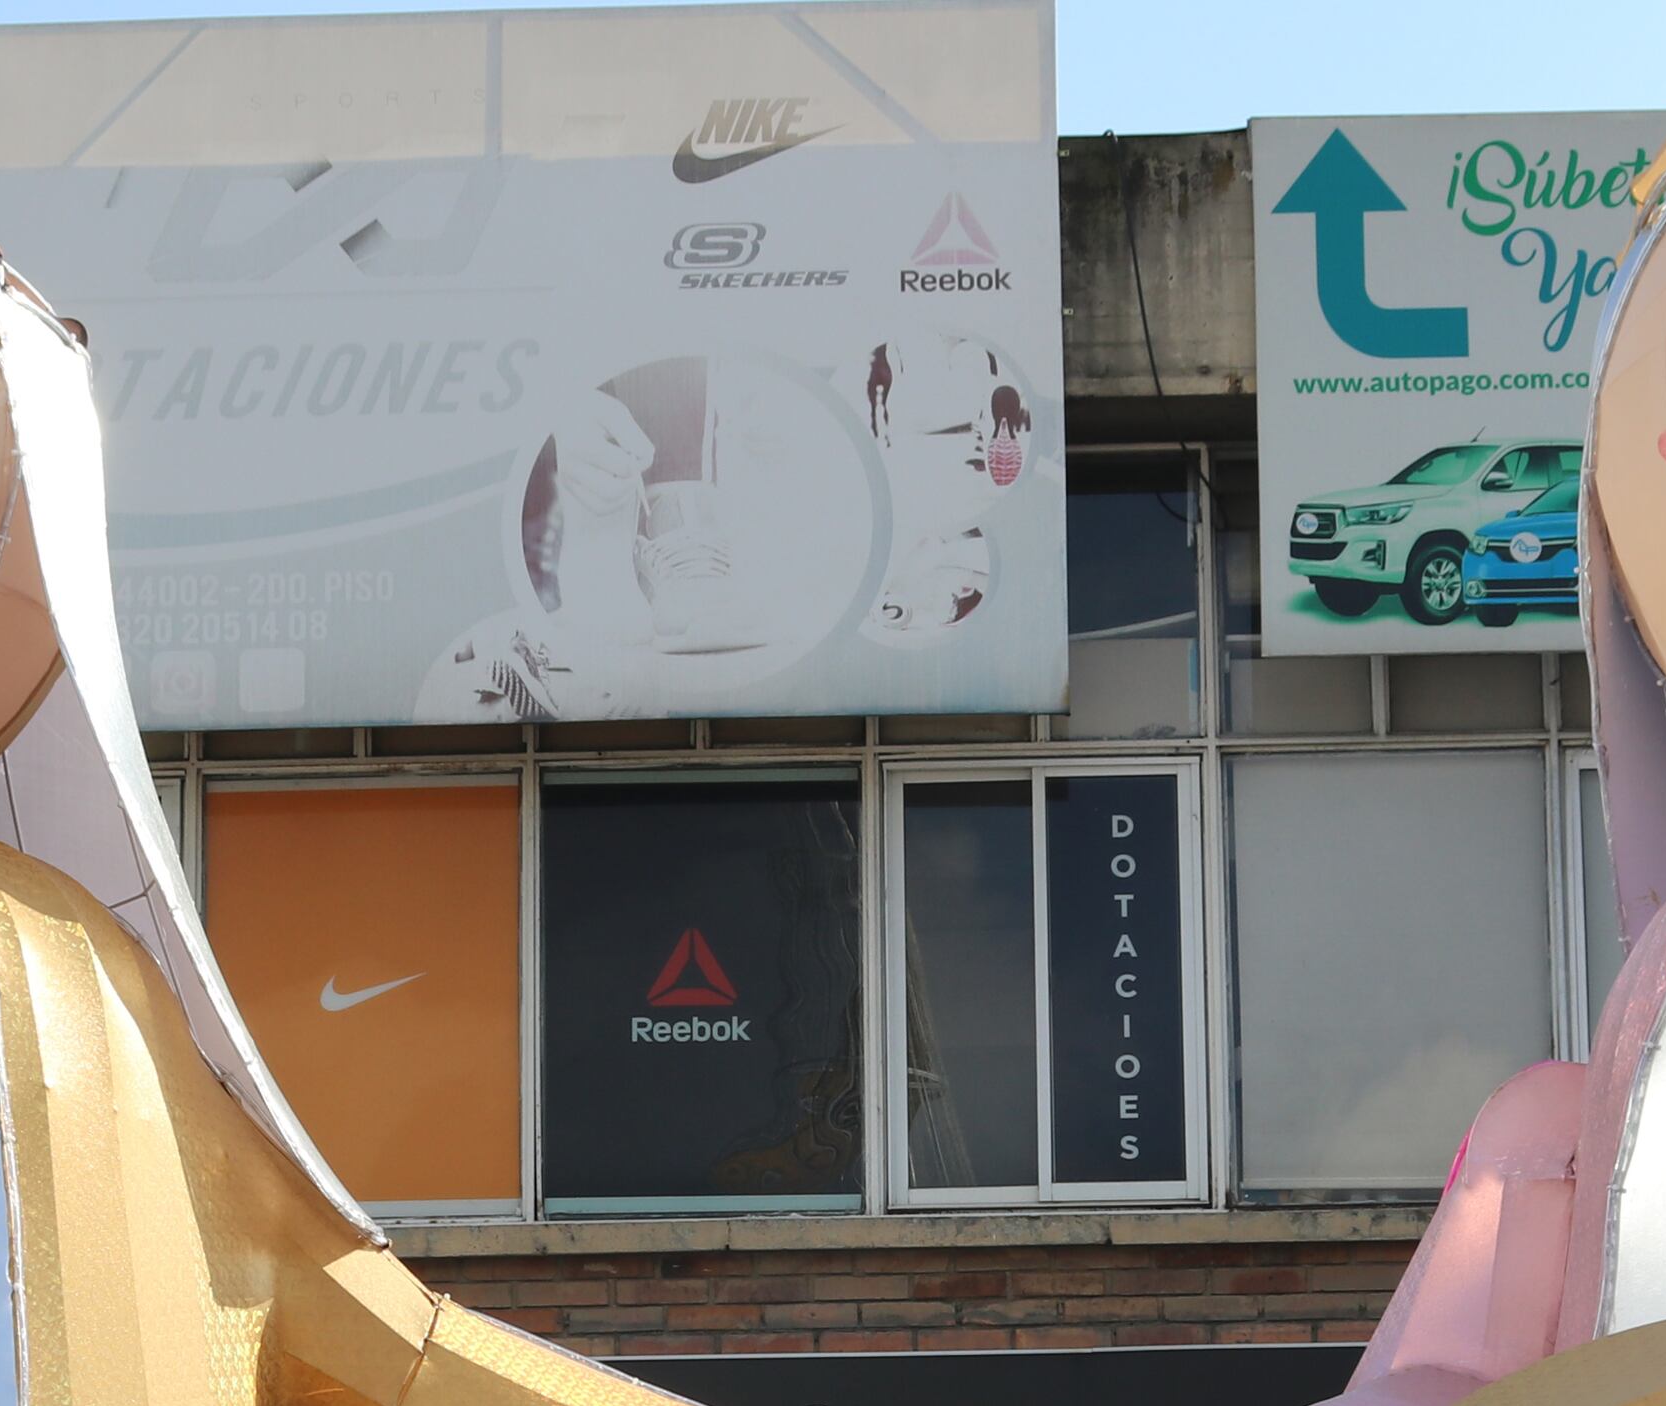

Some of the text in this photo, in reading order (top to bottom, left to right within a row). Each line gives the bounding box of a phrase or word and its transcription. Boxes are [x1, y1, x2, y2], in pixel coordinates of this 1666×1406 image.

[696, 97, 810, 145] NIKE
[678, 270, 850, 289] SKECHERS
[900, 269, 1012, 293] Reebok
[1502, 227, 1618, 353] Ya
[92, 338, 540, 423] TACIONES
[1293, 370, 1590, 398] www.autopago.com.co
[630, 1014, 752, 1044] Reebok
